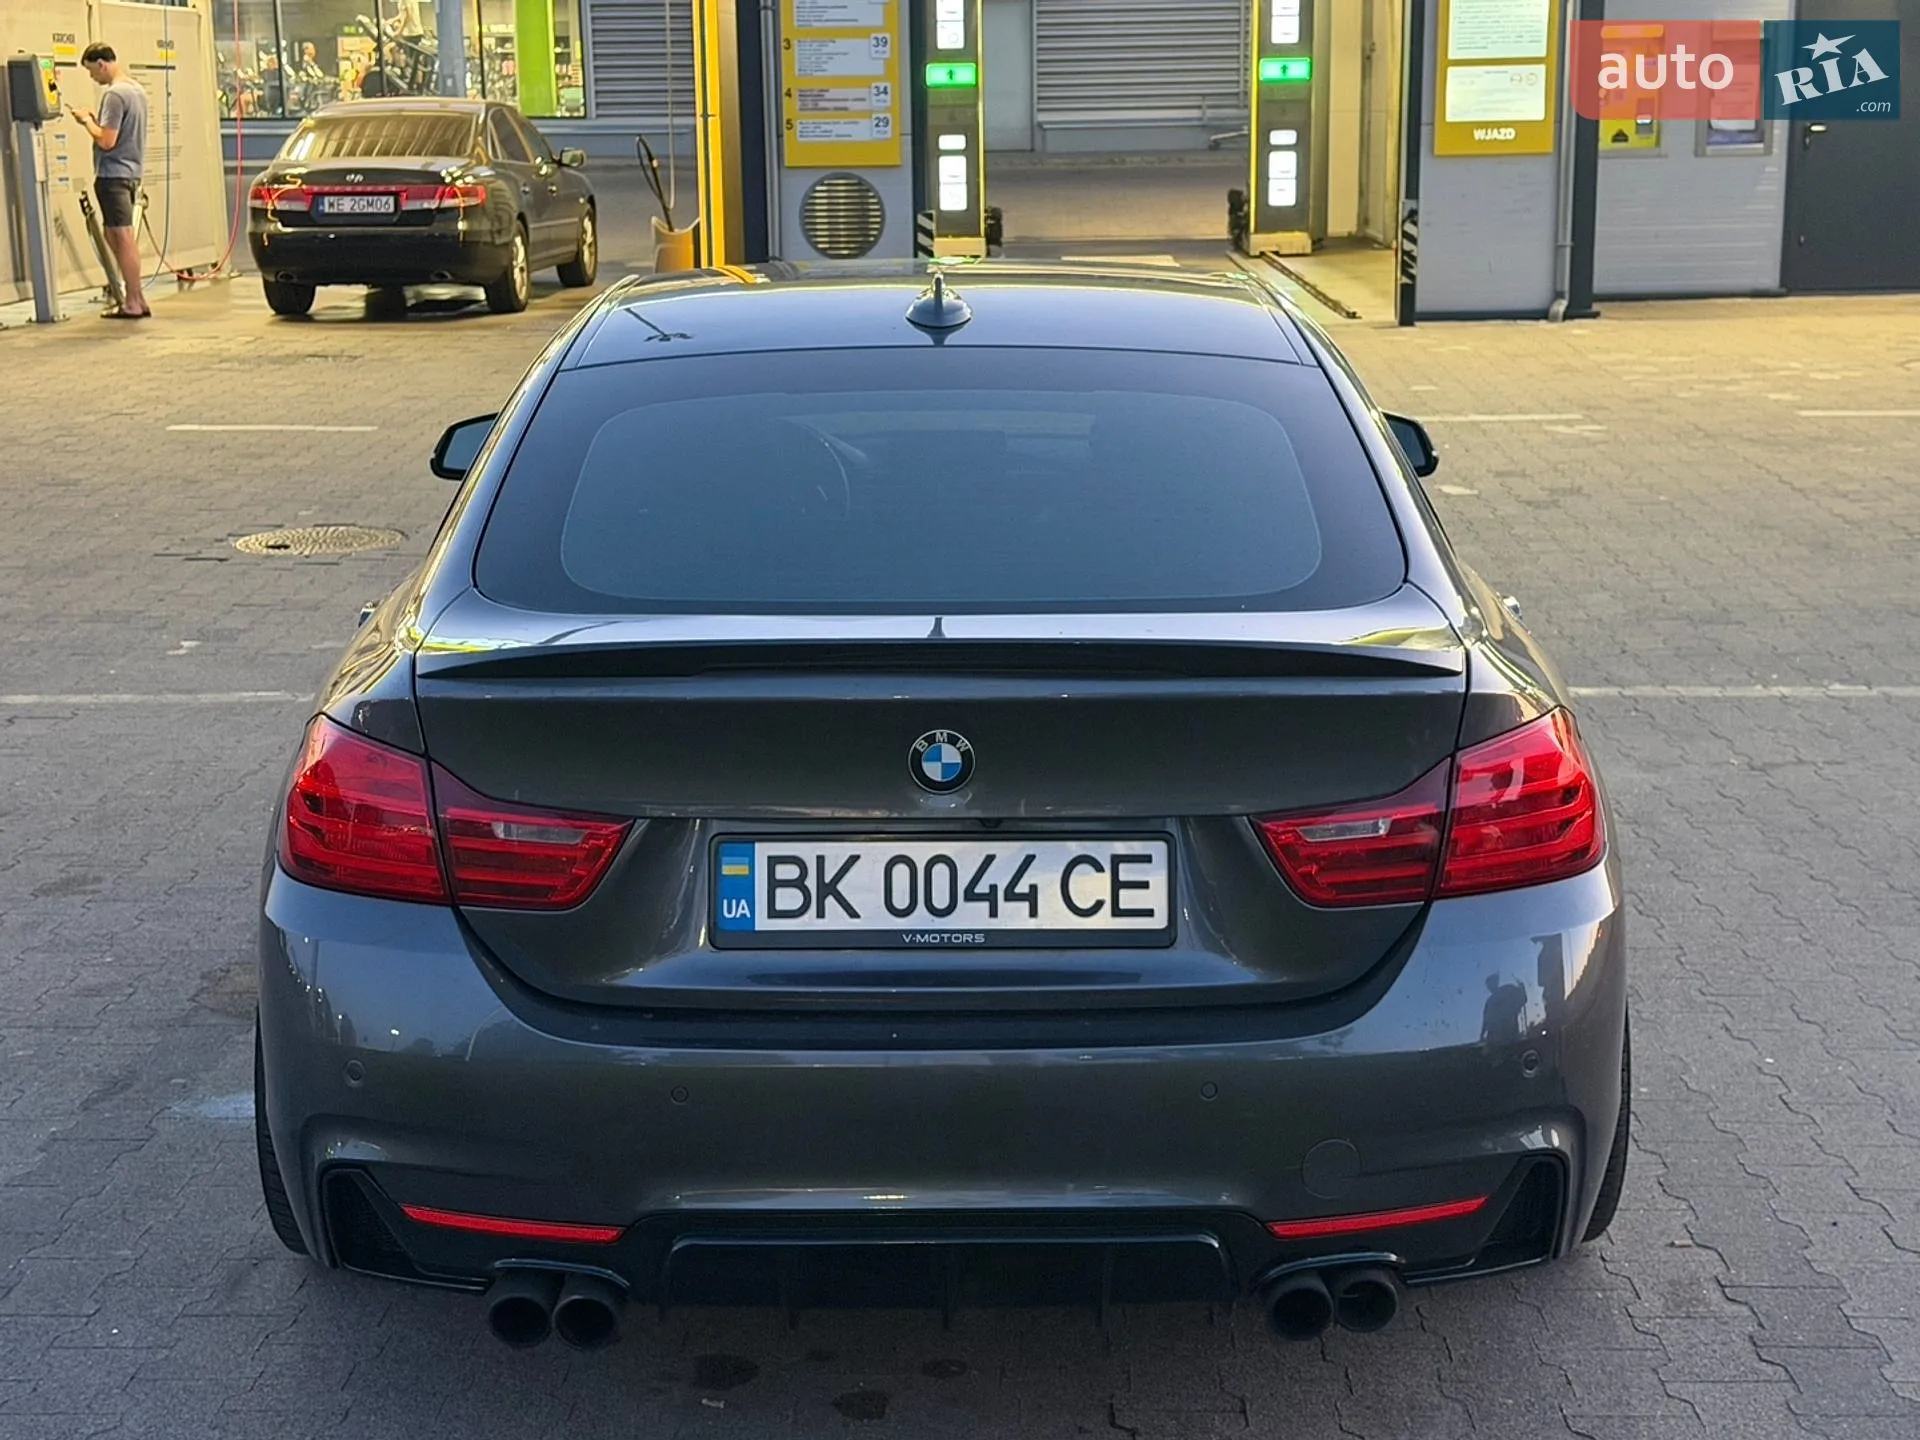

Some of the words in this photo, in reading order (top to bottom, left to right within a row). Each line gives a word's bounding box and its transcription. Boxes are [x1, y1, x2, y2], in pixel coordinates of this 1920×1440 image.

[783, 38, 792, 51] 3
[872, 36, 889, 48] 39
[784, 88, 793, 99] 4
[873, 85, 889, 97] 34
[785, 118, 794, 131] 5
[873, 116, 890, 129] 29
[327, 198, 345, 212] WE
[915, 731, 970, 753] BMW
[766, 854, 861, 919] BK
[883, 853, 1039, 919] 0044
[1059, 853, 1155, 919] CE
[722, 899, 751, 919] UA
